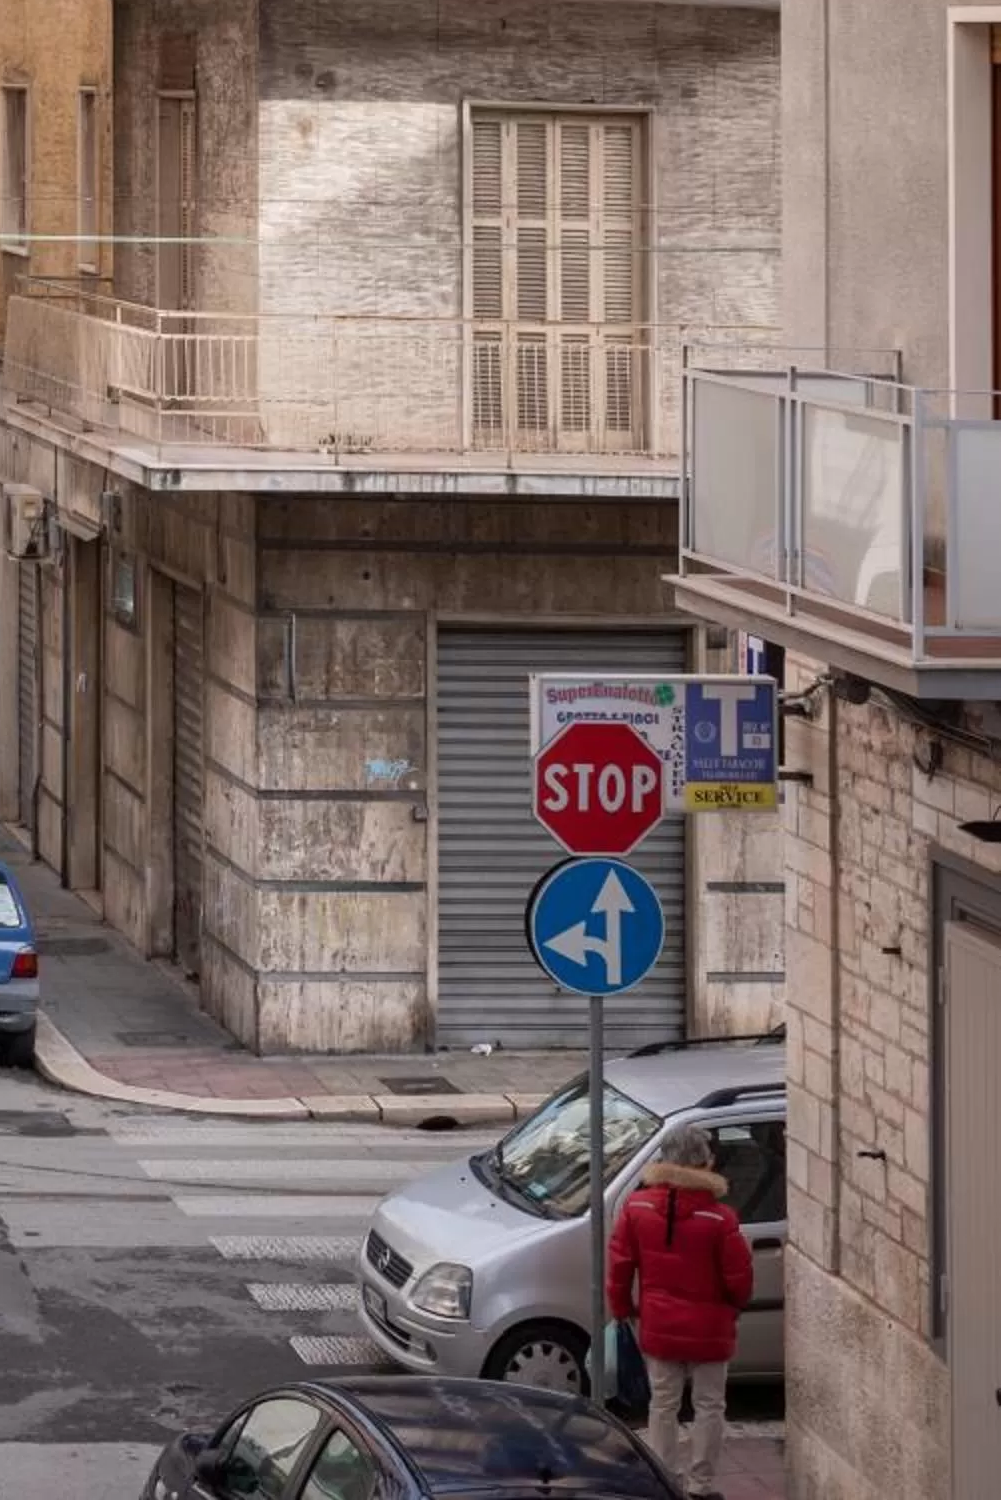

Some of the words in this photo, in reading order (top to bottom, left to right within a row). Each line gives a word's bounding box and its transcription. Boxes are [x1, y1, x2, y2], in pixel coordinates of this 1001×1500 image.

[702, 685, 756, 757] T
[543, 763, 657, 813] STOP
[695, 789, 764, 804] SERVICE
